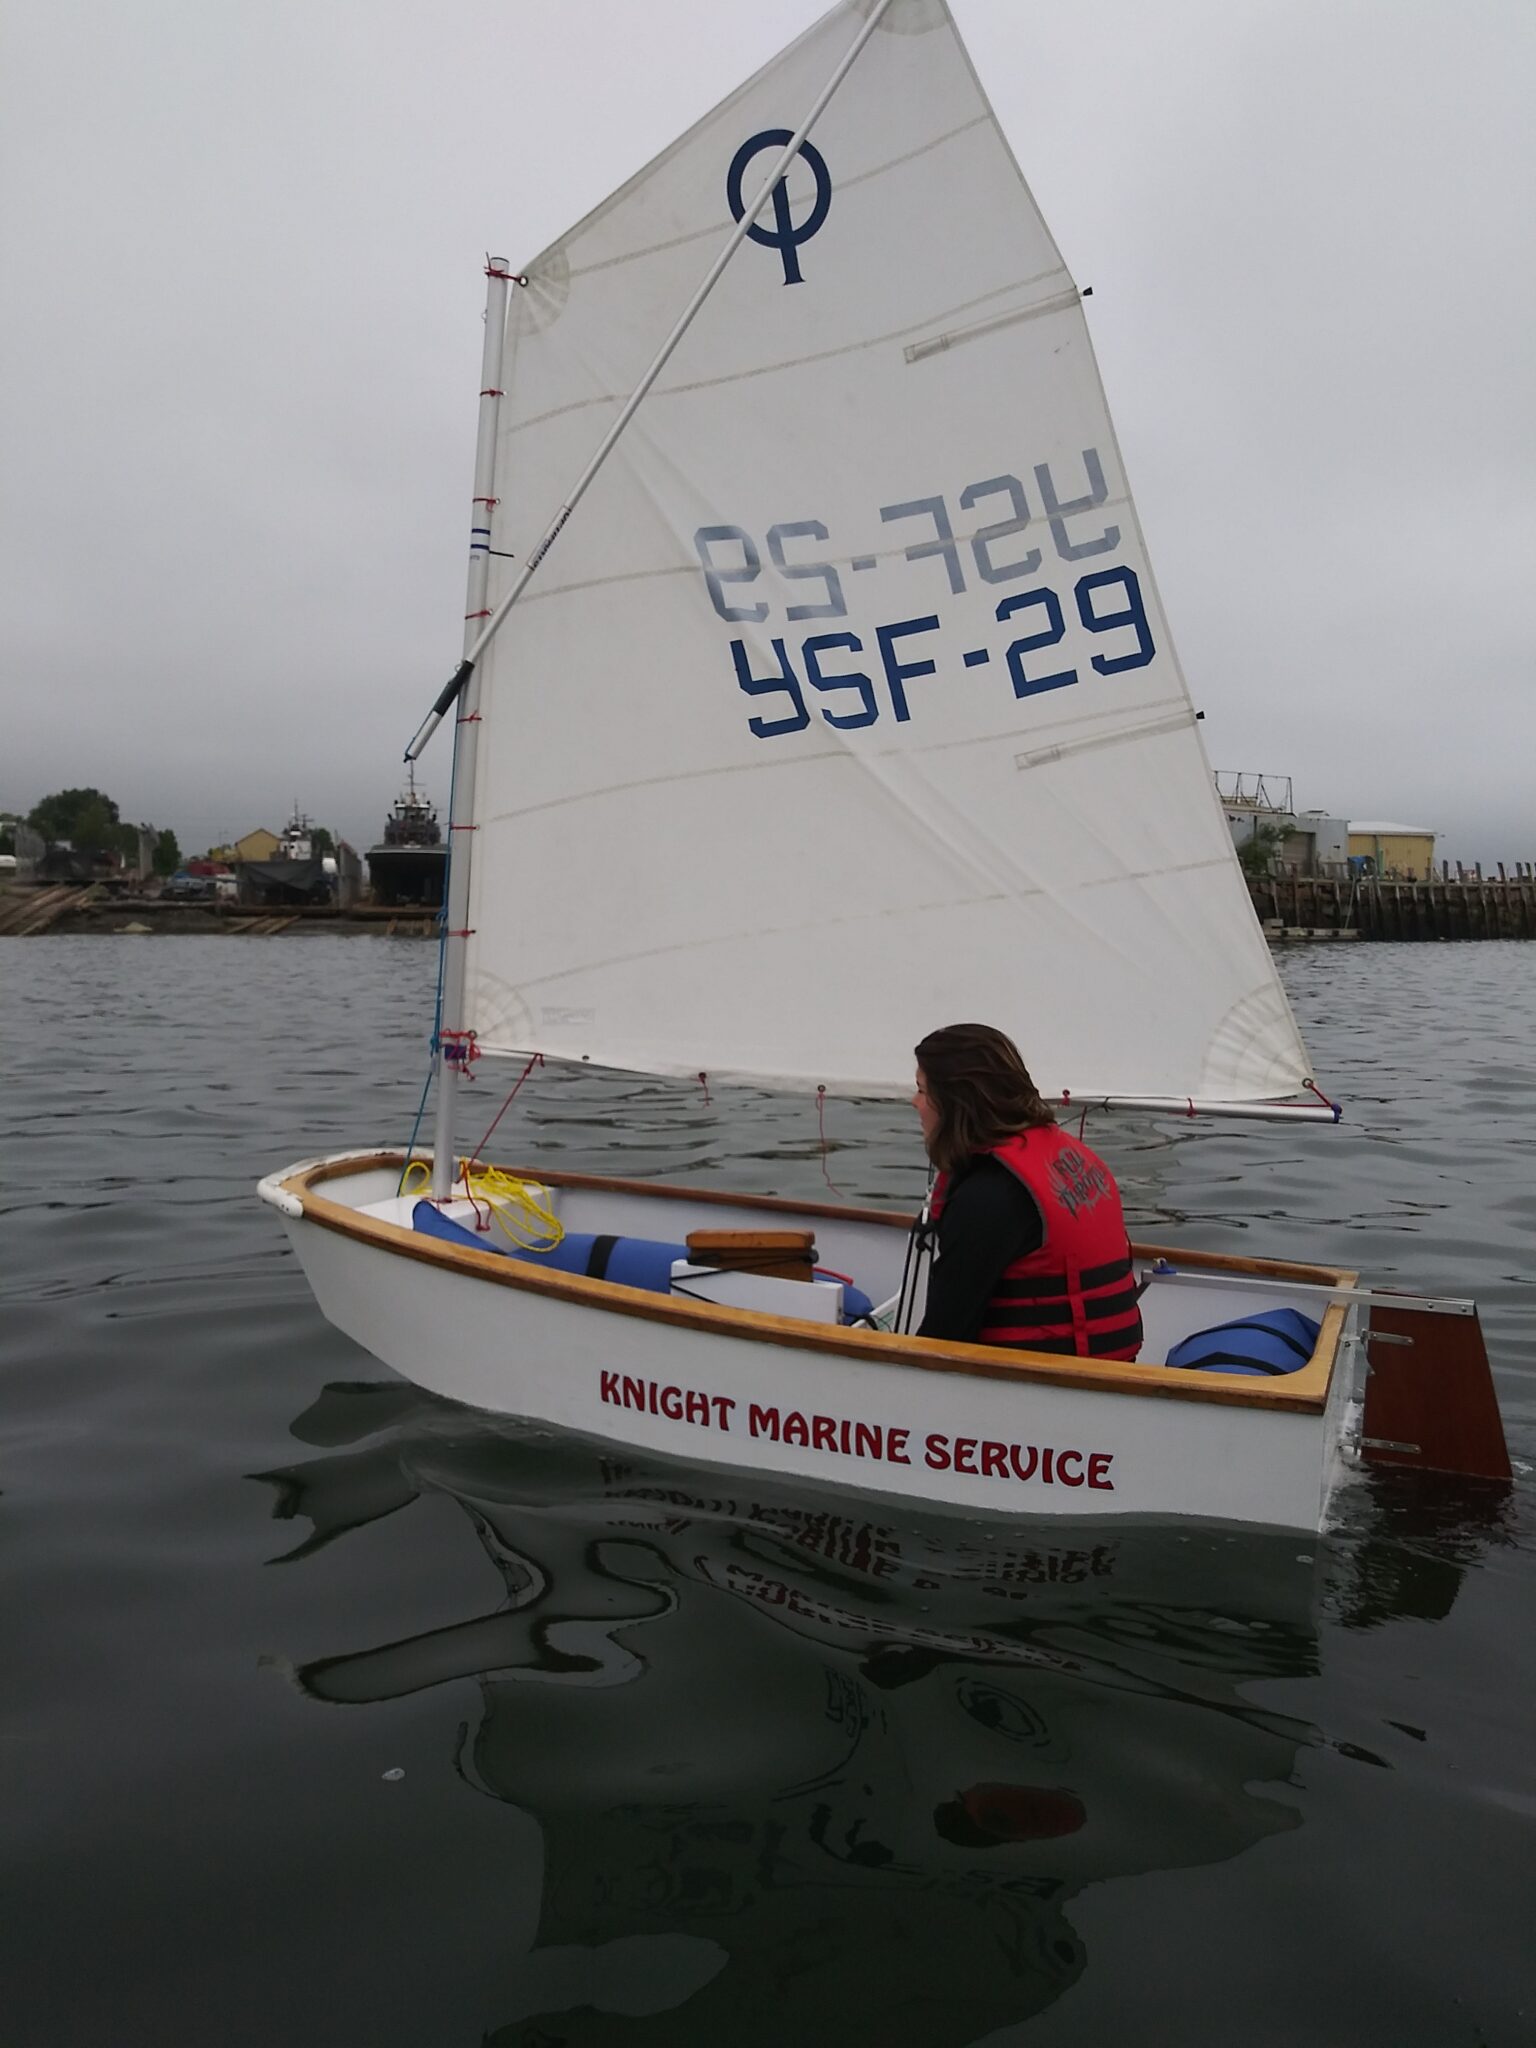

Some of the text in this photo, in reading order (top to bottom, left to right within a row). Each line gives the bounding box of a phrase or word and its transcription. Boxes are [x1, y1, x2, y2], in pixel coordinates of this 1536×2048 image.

[600, 1370, 1116, 1491] KNIGHT MARINE SERVICE
